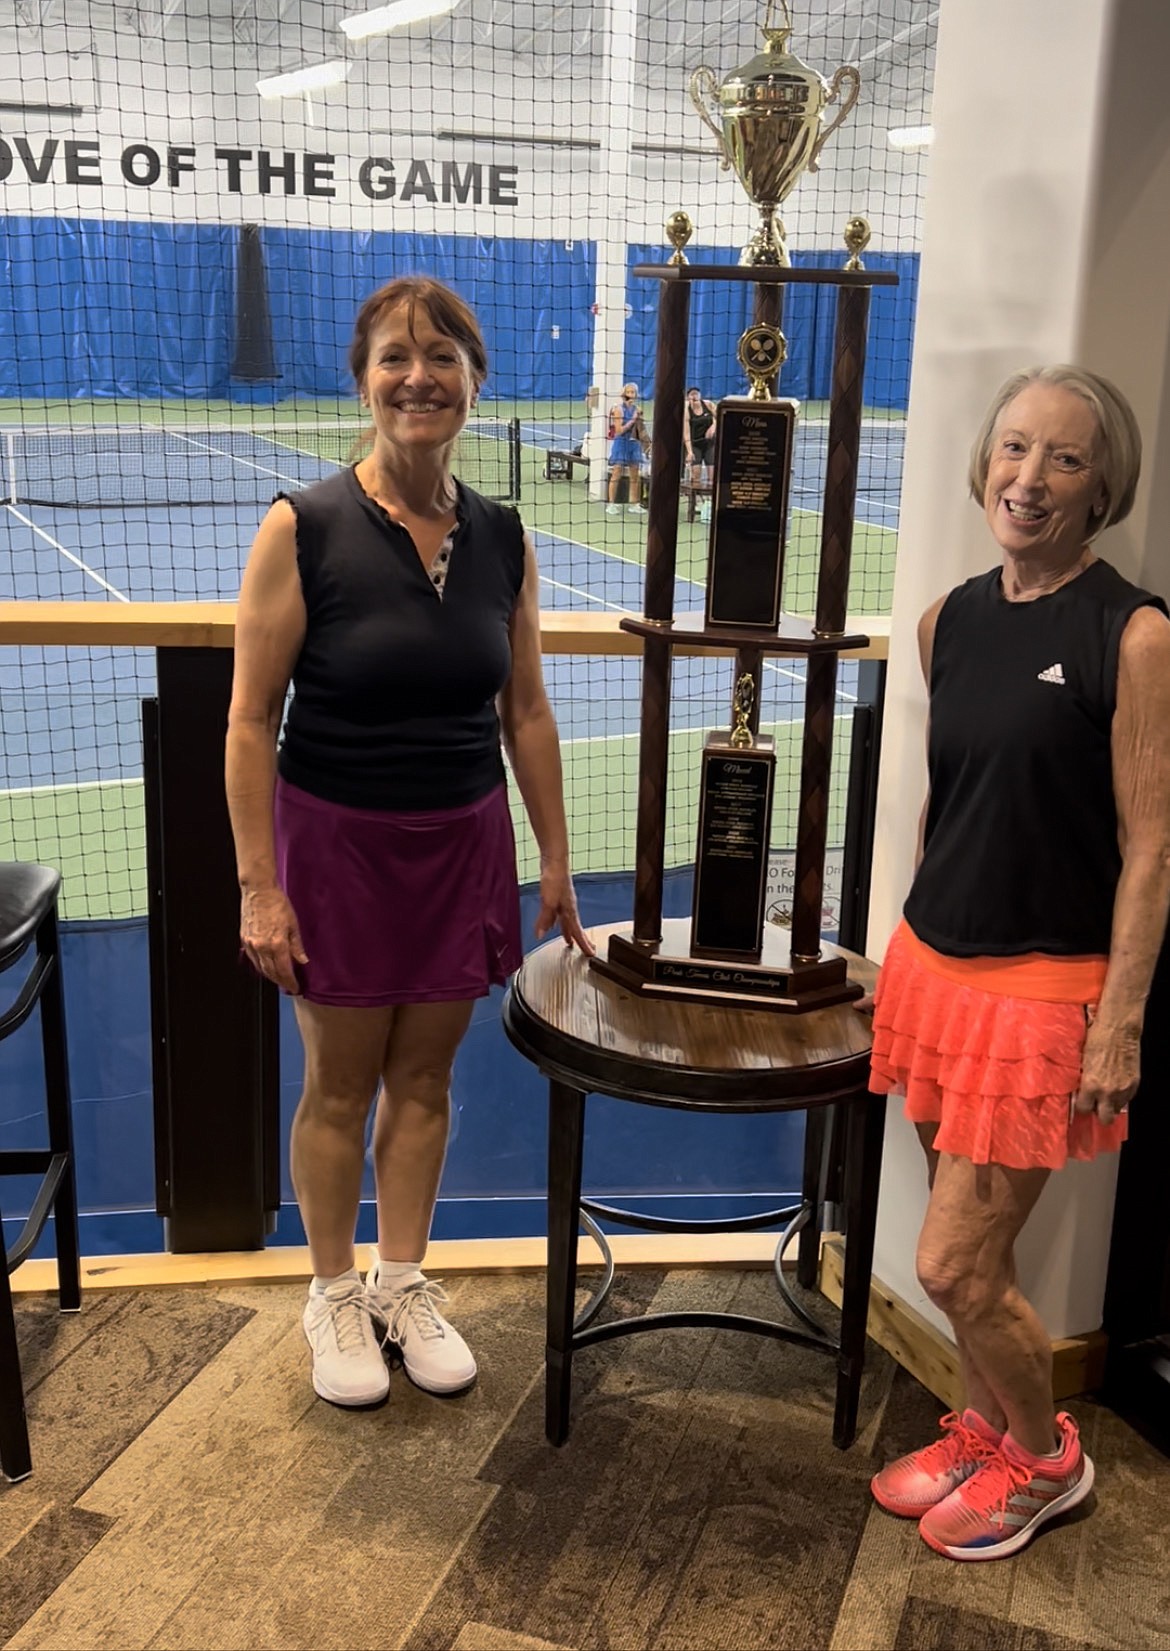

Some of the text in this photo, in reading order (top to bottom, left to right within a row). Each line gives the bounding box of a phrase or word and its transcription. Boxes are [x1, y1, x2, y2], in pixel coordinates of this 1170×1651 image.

[120, 143, 196, 188] OF
[215, 148, 336, 197] THE
[358, 157, 519, 206] GAME
[768, 867, 779, 879] O
[781, 867, 795, 878] Fo
